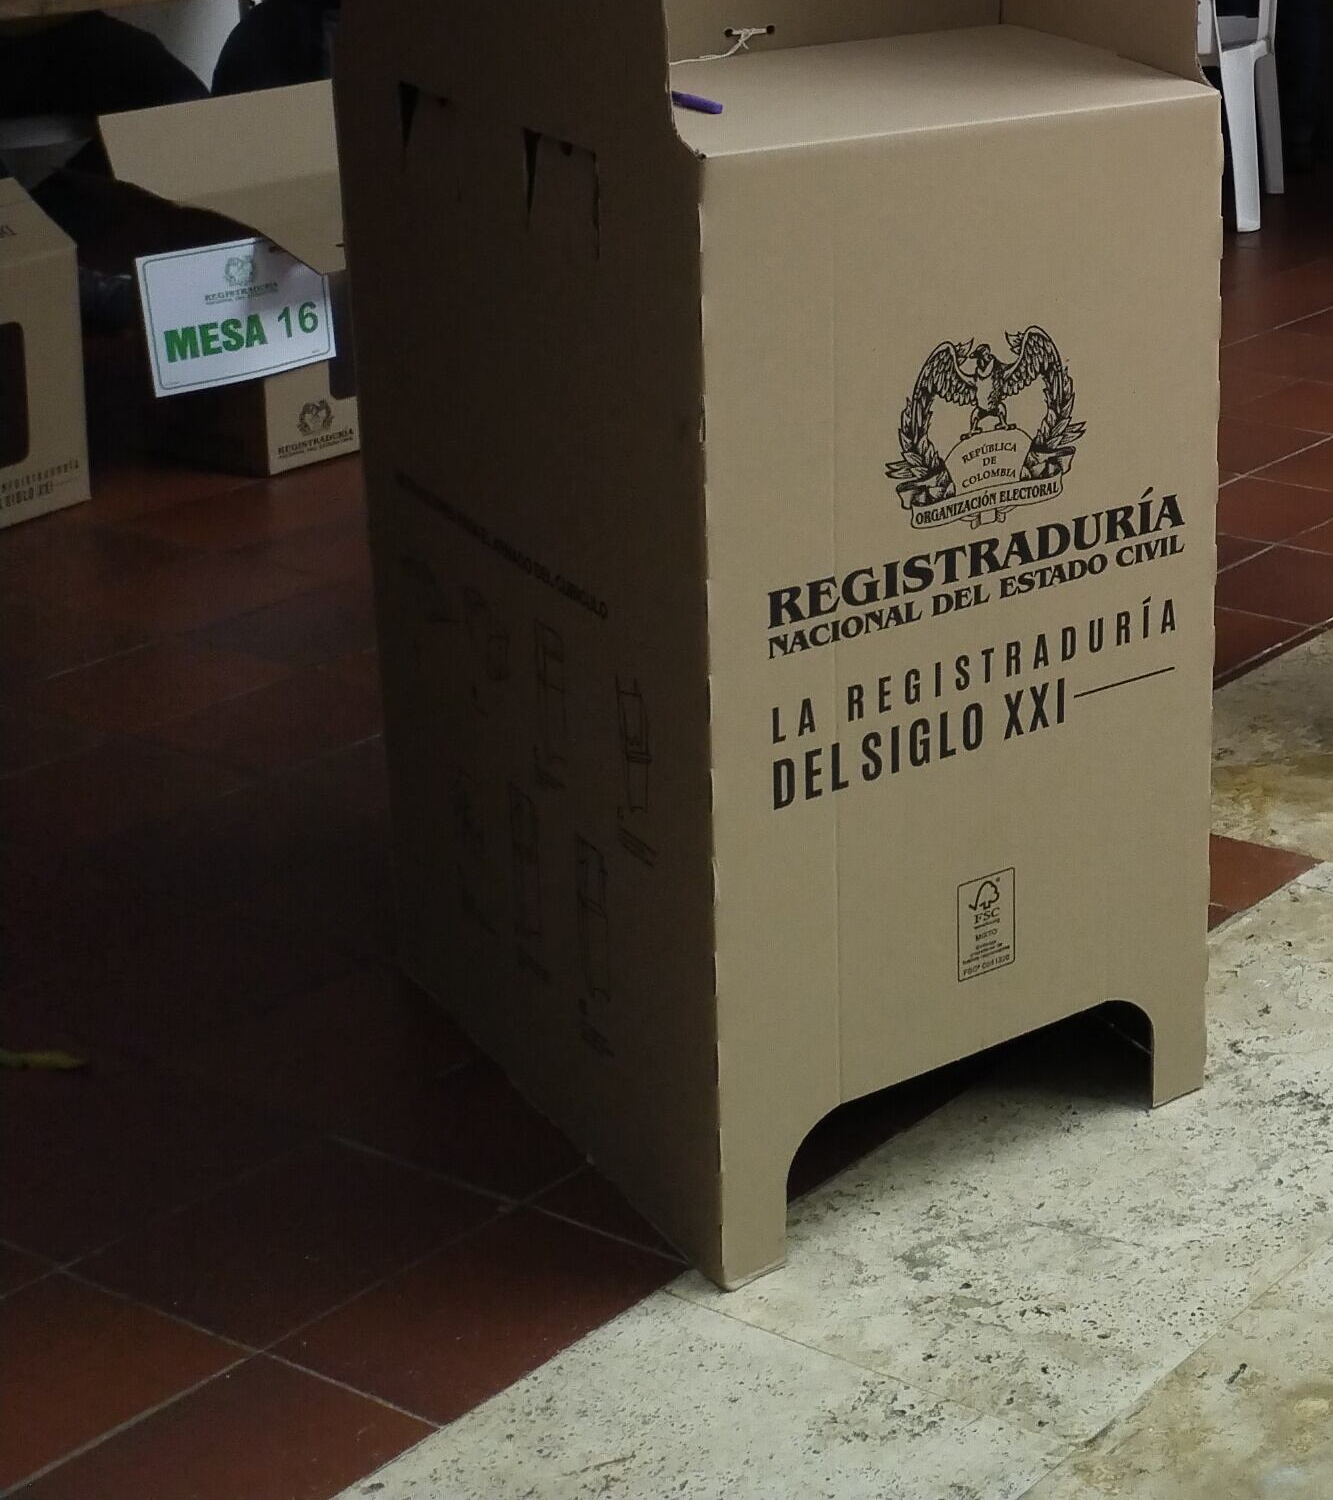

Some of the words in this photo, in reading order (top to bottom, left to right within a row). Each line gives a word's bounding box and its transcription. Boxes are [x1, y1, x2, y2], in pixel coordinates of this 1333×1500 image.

[164, 314, 268, 364] MESA
[277, 301, 318, 338] 16
[961, 468, 1016, 488] COLOMBIA
[962, 442, 1017, 464] REPÚBLICA
[982, 457, 997, 467] DE
[915, 491, 997, 525] ORGANIZACIÓN
[1001, 481, 1059, 503] ELECTORAL
[767, 486, 1185, 628] REGISTRADURÍA
[768, 602, 922, 659] NACIONAL
[931, 586, 990, 619] DEL
[998, 553, 1108, 600] ESTADO
[1115, 535, 1184, 571] CIVIL
[771, 698, 816, 744] LA
[847, 598, 1177, 722] REGISTRADURÍA
[773, 747, 850, 812] DEL
[861, 703, 984, 783] SIGLO
[1002, 677, 1067, 742] XXI
[974, 907, 1000, 924] FSC
